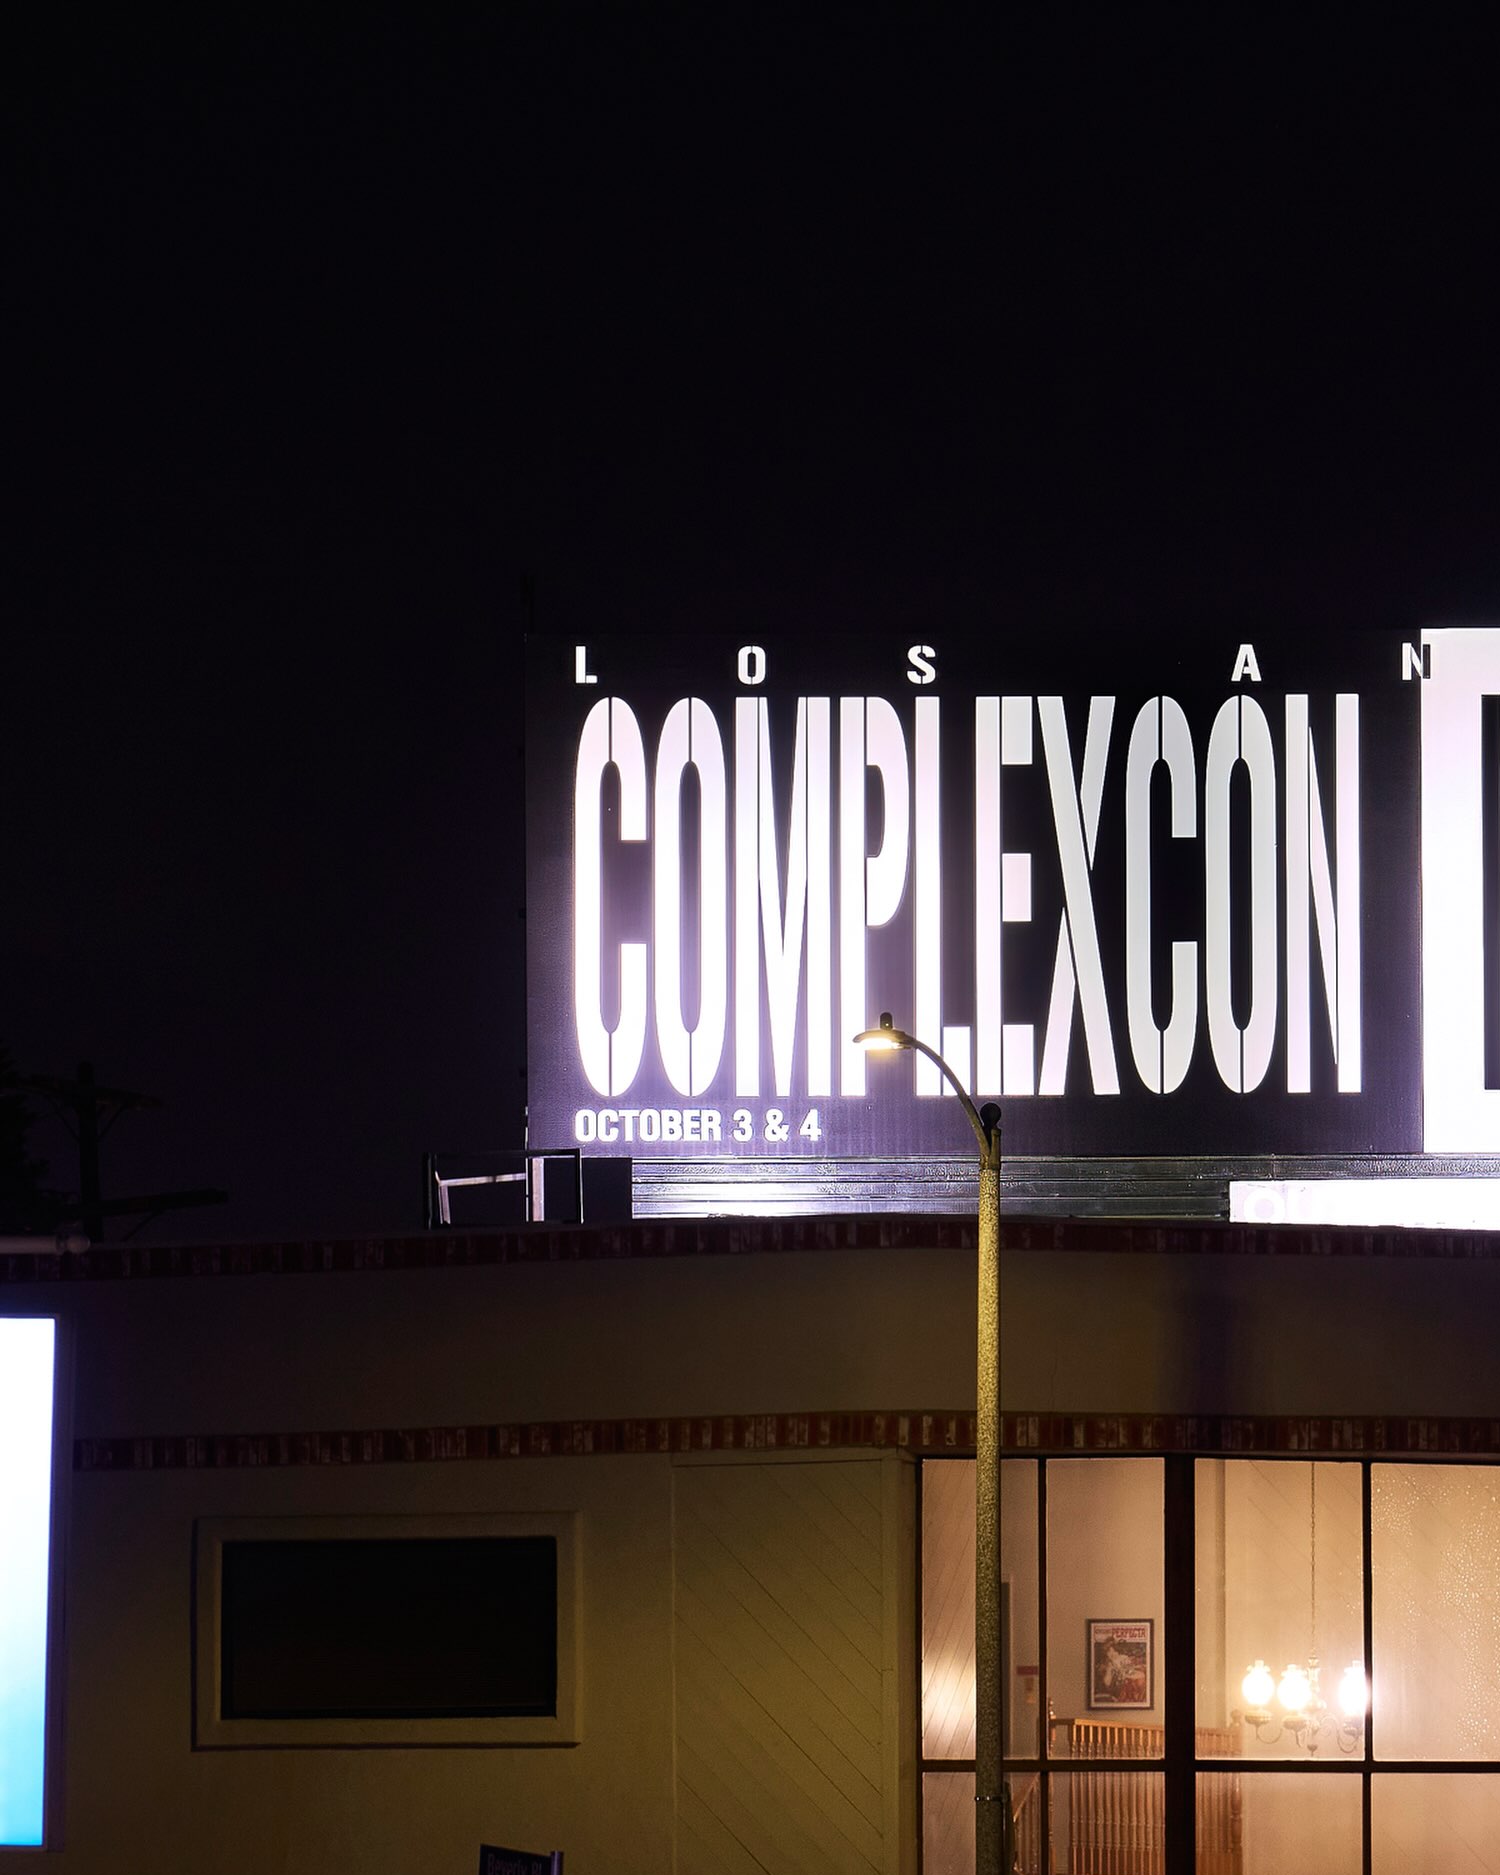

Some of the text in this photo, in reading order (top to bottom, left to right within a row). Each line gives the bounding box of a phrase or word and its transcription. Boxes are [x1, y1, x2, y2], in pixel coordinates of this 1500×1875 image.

[574, 693, 1362, 1097] COMPLEXCON
[574, 1108, 823, 1142] OCTOBER 3 & 4
